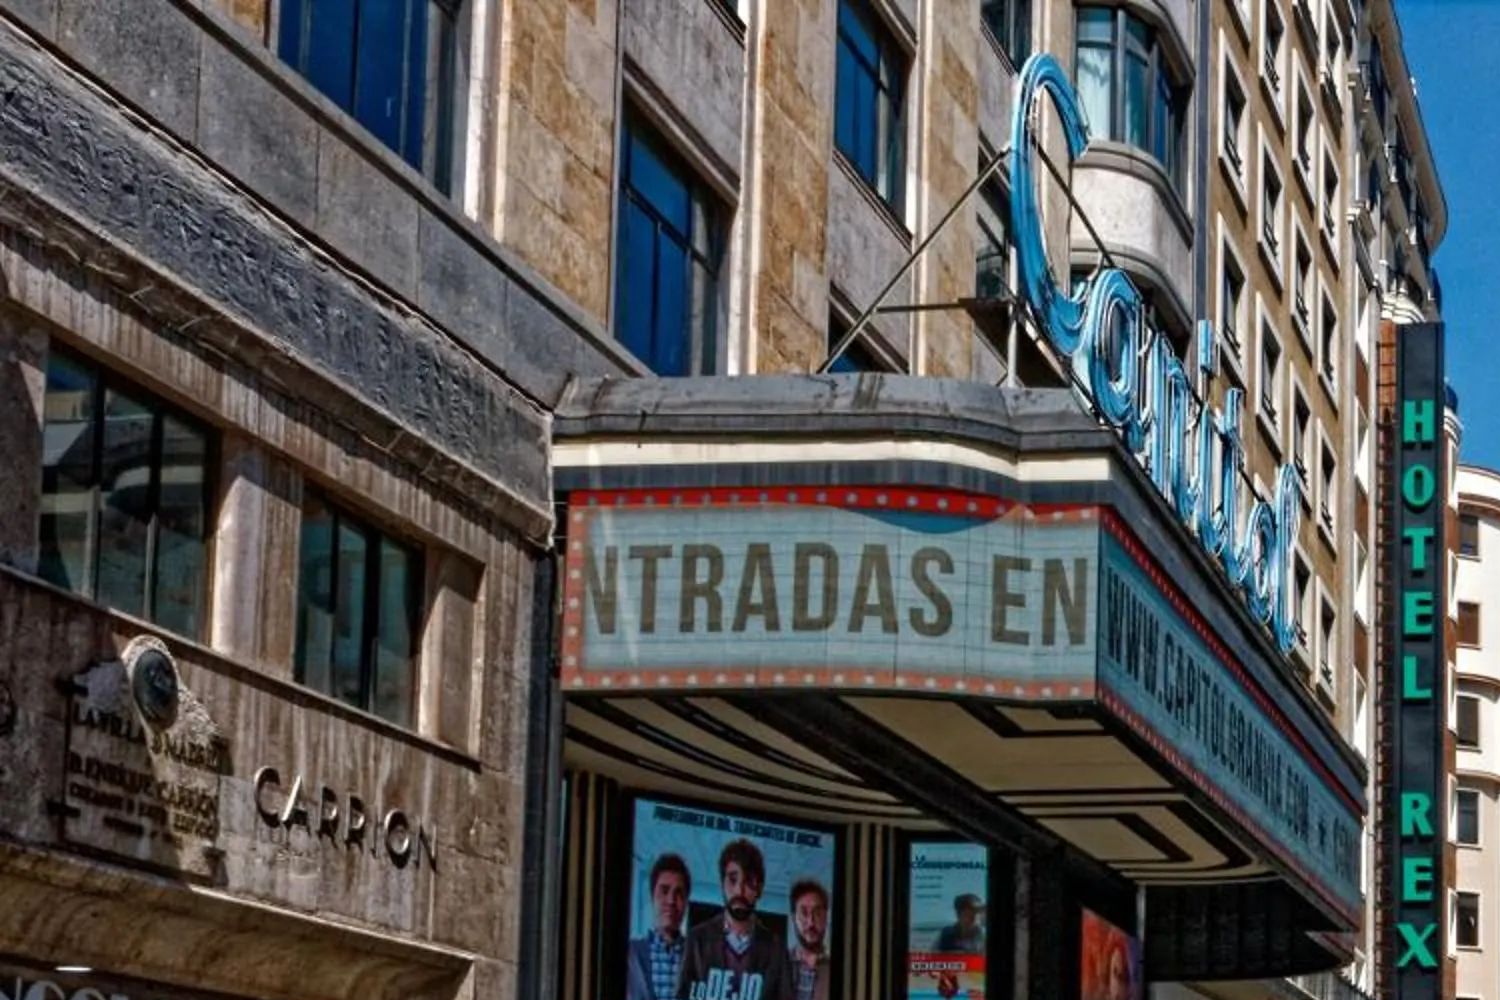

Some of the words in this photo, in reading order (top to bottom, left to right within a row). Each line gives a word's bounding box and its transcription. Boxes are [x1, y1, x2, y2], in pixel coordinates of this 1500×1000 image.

[990, 553, 1089, 646] EN
[1402, 399, 1435, 700] HOTEL
[1399, 793, 1438, 967] REX
[689, 980, 706, 1000] LO
